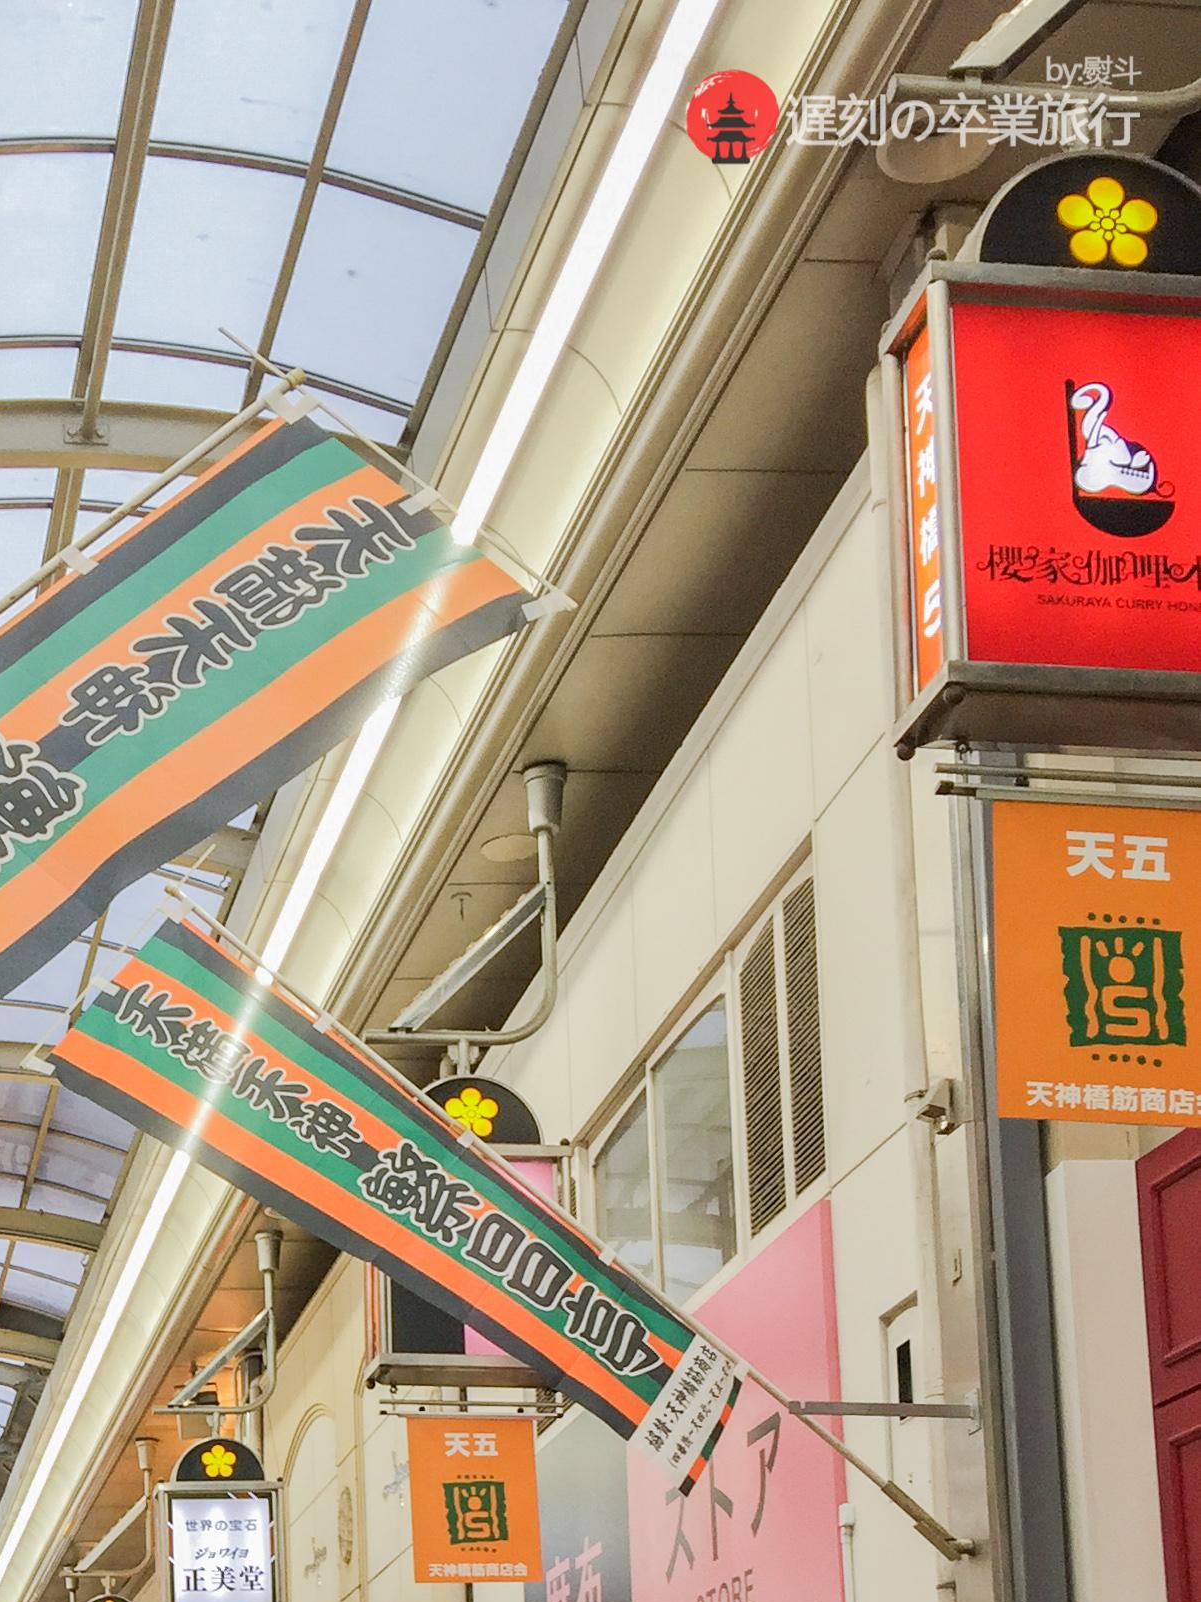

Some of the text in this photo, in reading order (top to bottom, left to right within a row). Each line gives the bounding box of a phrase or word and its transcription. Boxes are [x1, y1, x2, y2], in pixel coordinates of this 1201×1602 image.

[1037, 594, 1112, 609] SAKURAYA
[1115, 597, 1163, 610] CURRY
[1065, 831, 1171, 882] 天五
[445, 1433, 498, 1456] 天五
[665, 1410, 781, 1582] ストア
[185, 1519, 257, 1532] 世界の宝石
[182, 1566, 265, 1592] 正美堂
